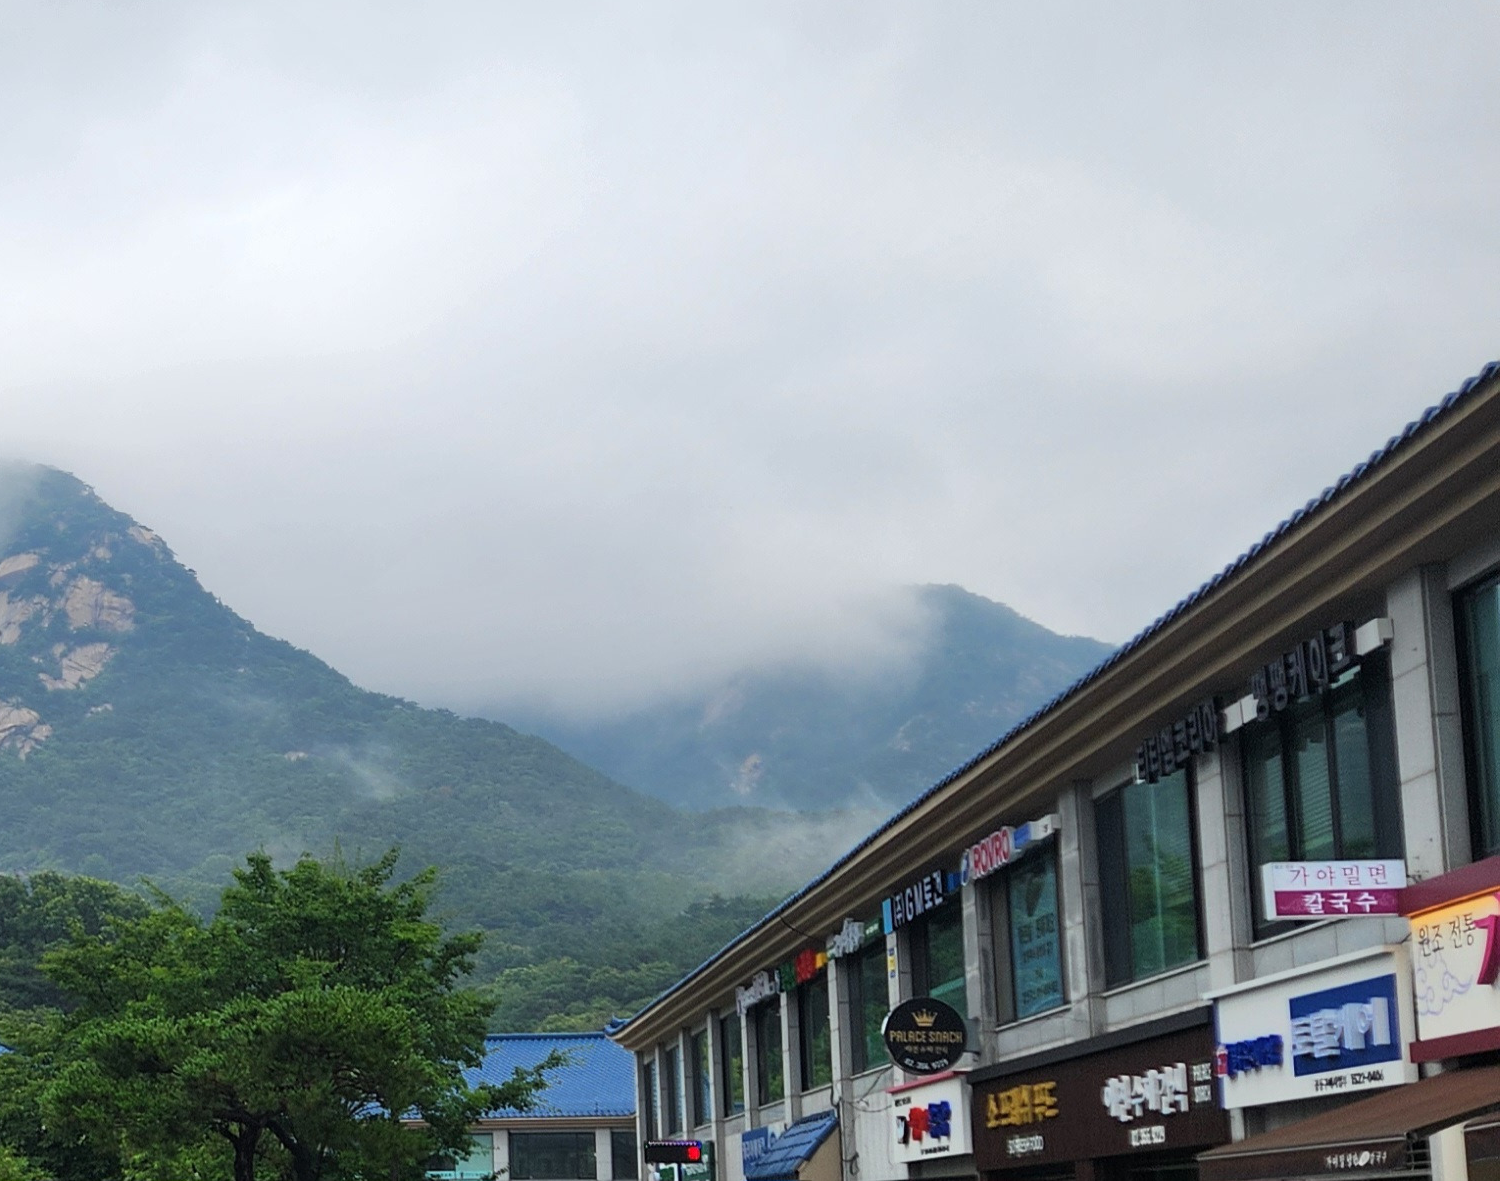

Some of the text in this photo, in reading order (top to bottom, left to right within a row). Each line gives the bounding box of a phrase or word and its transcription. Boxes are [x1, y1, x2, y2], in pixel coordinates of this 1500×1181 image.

[1289, 864, 1388, 886] 가야밀면
[1302, 890, 1378, 914] 칼국수
[1417, 913, 1477, 958] 원조 전통
[889, 1030, 927, 1043] PALACE
